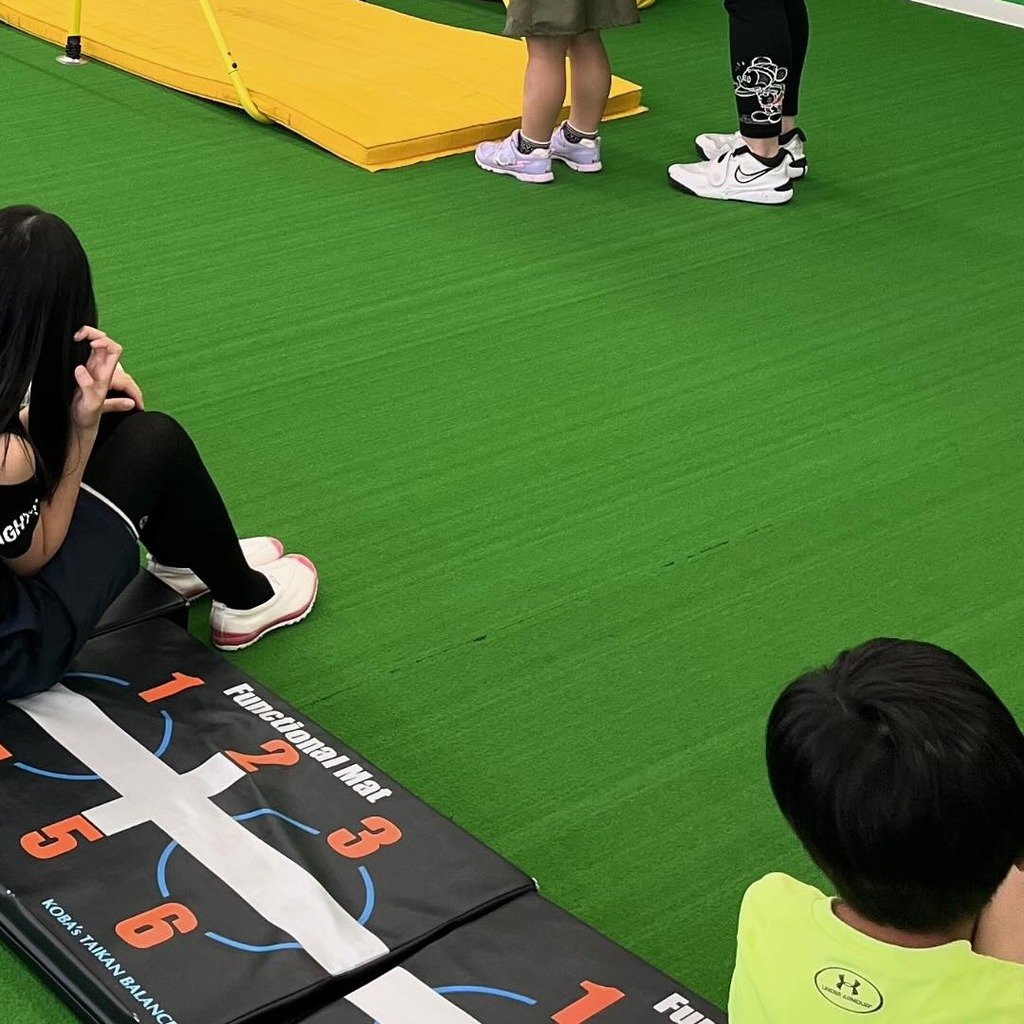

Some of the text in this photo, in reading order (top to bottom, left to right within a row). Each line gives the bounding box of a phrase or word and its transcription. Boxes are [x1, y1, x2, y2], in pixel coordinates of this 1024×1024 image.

[139, 672, 204, 704] 1
[222, 682, 393, 804] Functional Mat
[224, 738, 301, 774] 2
[19, 814, 104, 860] 5
[326, 816, 402, 860] 3
[41, 897, 83, 936] KOBA's
[79, 934, 126, 977] TAIKAN
[114, 901, 199, 950] 6
[550, 980, 626, 1024] 1
